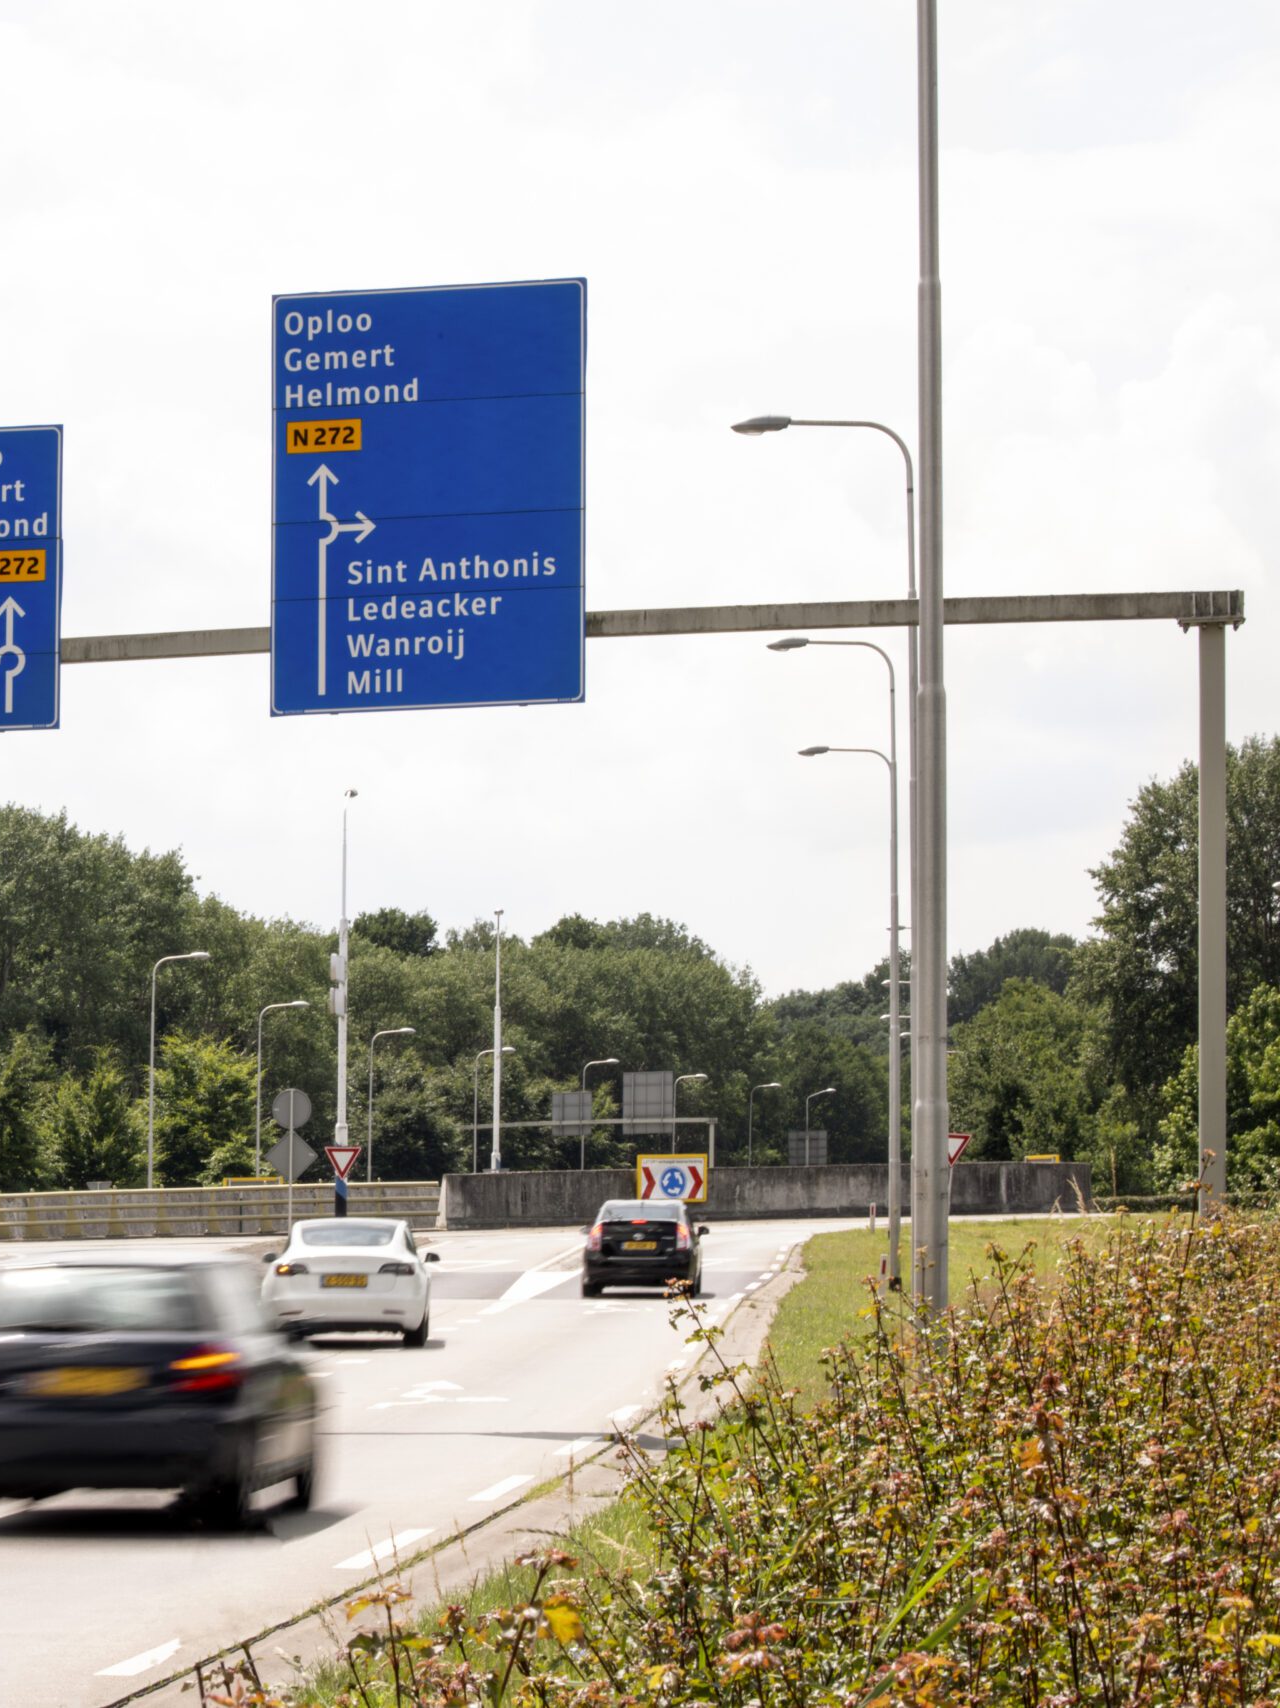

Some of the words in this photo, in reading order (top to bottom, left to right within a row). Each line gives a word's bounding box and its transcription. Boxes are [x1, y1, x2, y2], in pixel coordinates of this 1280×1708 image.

[285, 310, 371, 340] Oploo
[285, 345, 394, 371] Gemert
[286, 378, 418, 408] Helmond
[348, 560, 407, 584] Sint
[419, 552, 555, 581] Anthonis
[349, 593, 501, 621] Ledeacker
[347, 629, 463, 659] Wanroij
[348, 669, 402, 694] Mill
